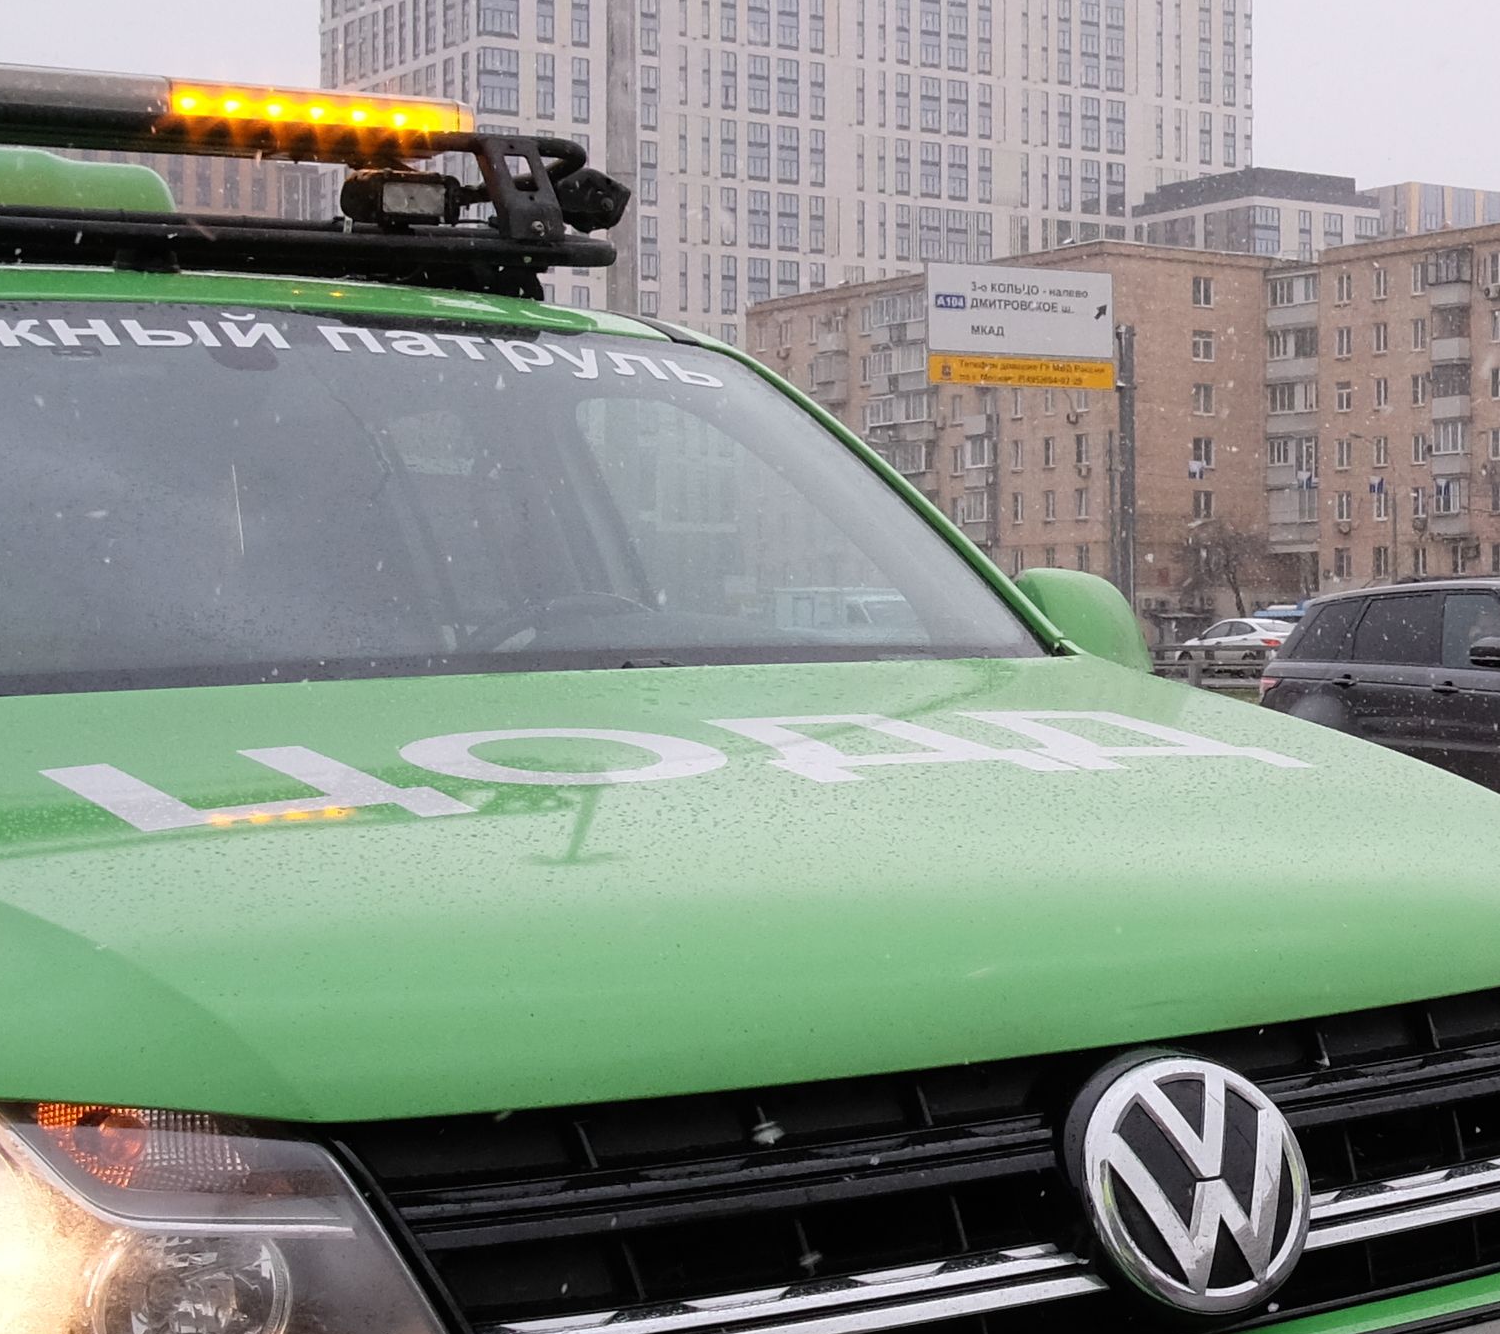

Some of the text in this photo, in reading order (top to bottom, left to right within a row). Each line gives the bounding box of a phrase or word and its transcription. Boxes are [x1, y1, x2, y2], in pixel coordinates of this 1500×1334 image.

[991, 282, 1039, 296] КОЛЬЦО
[1049, 288, 1089, 299] налево
[970, 297, 1058, 313] ДМИТРОВСКОЕ
[971, 325, 1005, 337] МКАД
[317, 325, 724, 388] патруль
[40, 711, 1313, 833] ЦОДД
